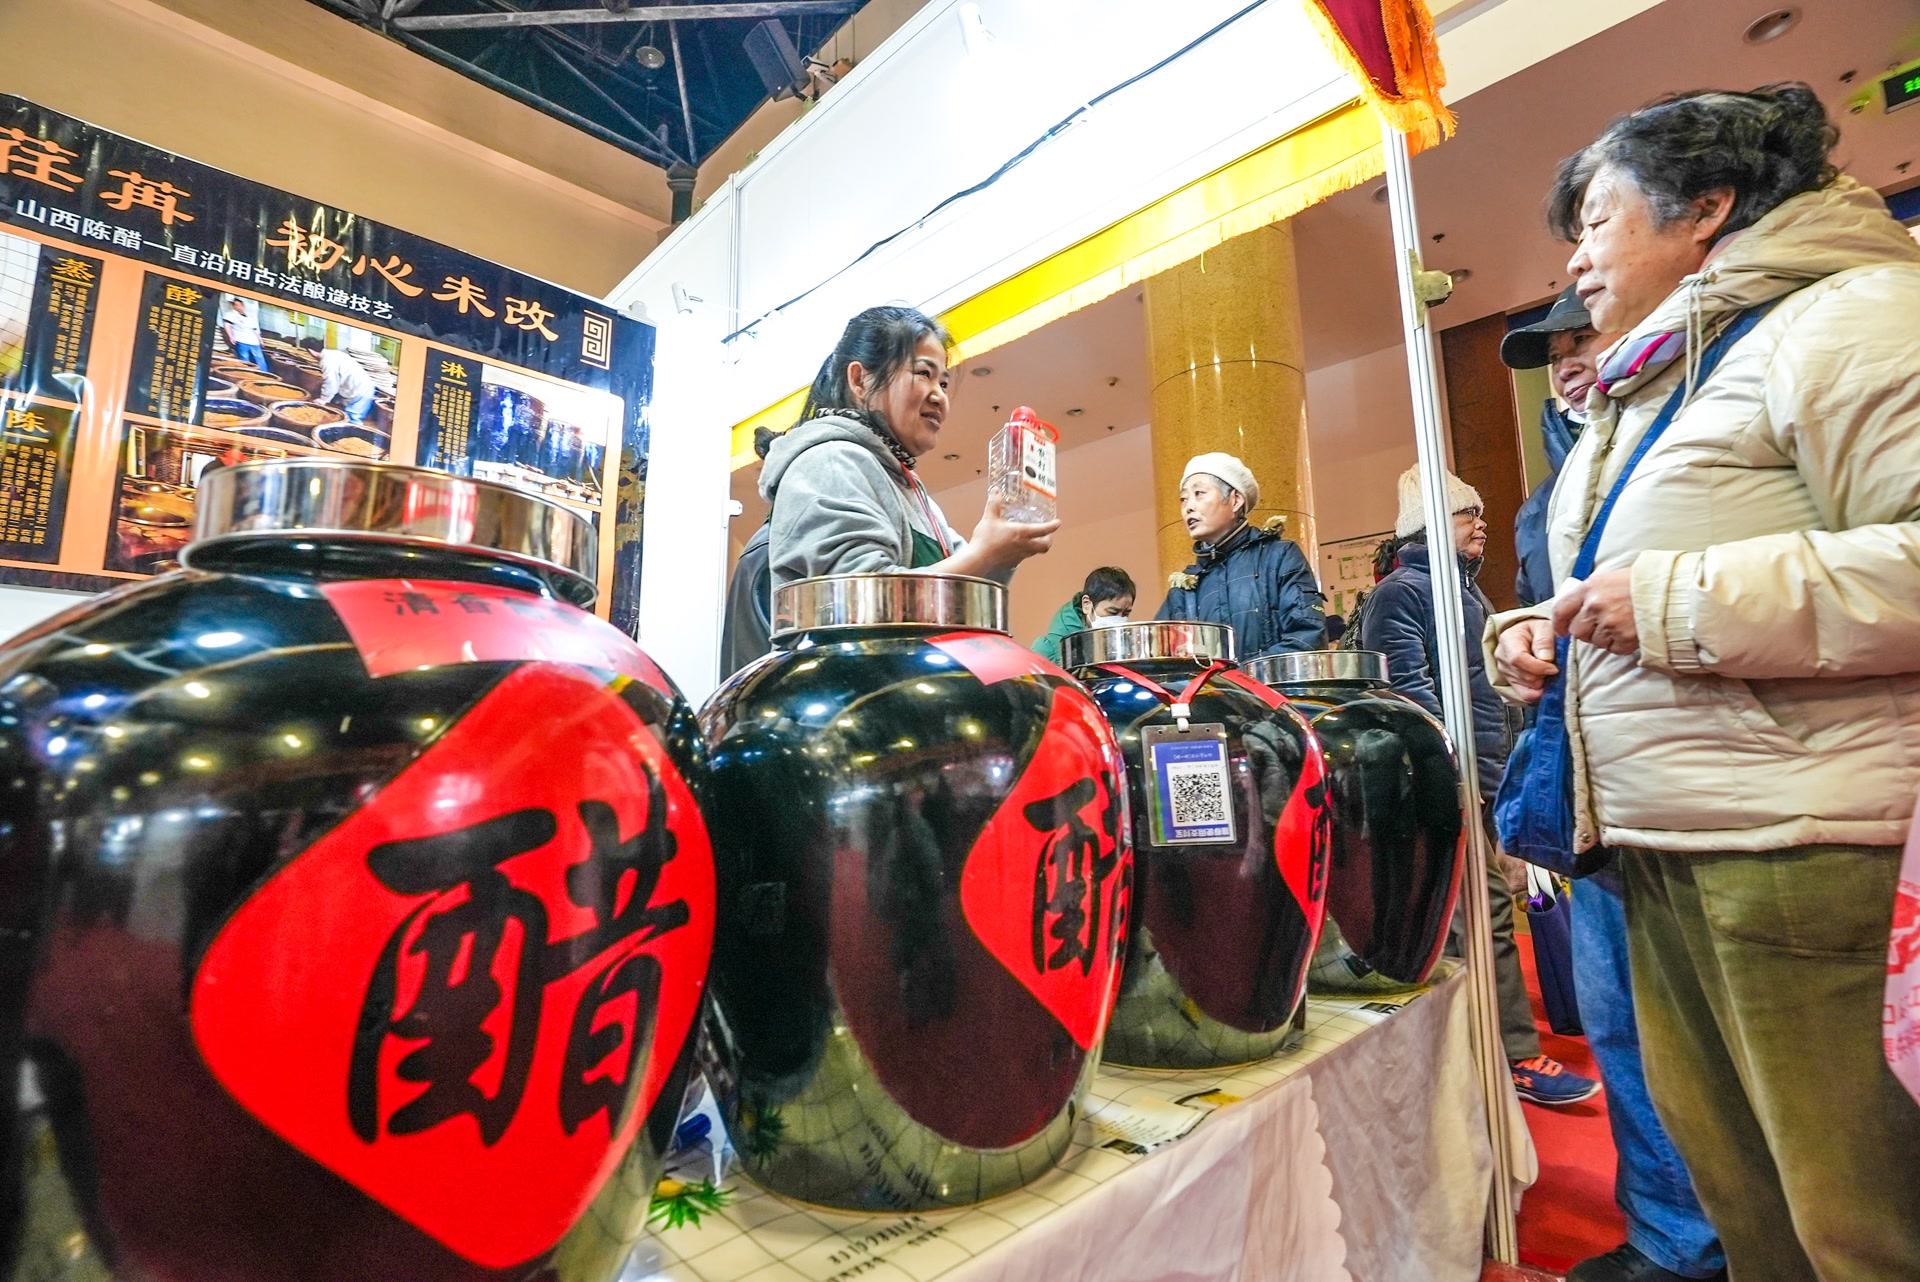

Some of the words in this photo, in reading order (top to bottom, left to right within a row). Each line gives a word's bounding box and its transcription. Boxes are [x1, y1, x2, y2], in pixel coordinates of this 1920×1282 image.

[16, 199, 394, 321] 山西陈醋一直沿用古法酿造技艺
[51, 257, 95, 281] 蒸
[266, 219, 559, 342] 初心未改
[166, 284, 203, 306] 酵
[440, 360, 468, 379] 淋
[5, 410, 49, 434] 陈
[348, 760, 690, 1147] 醋
